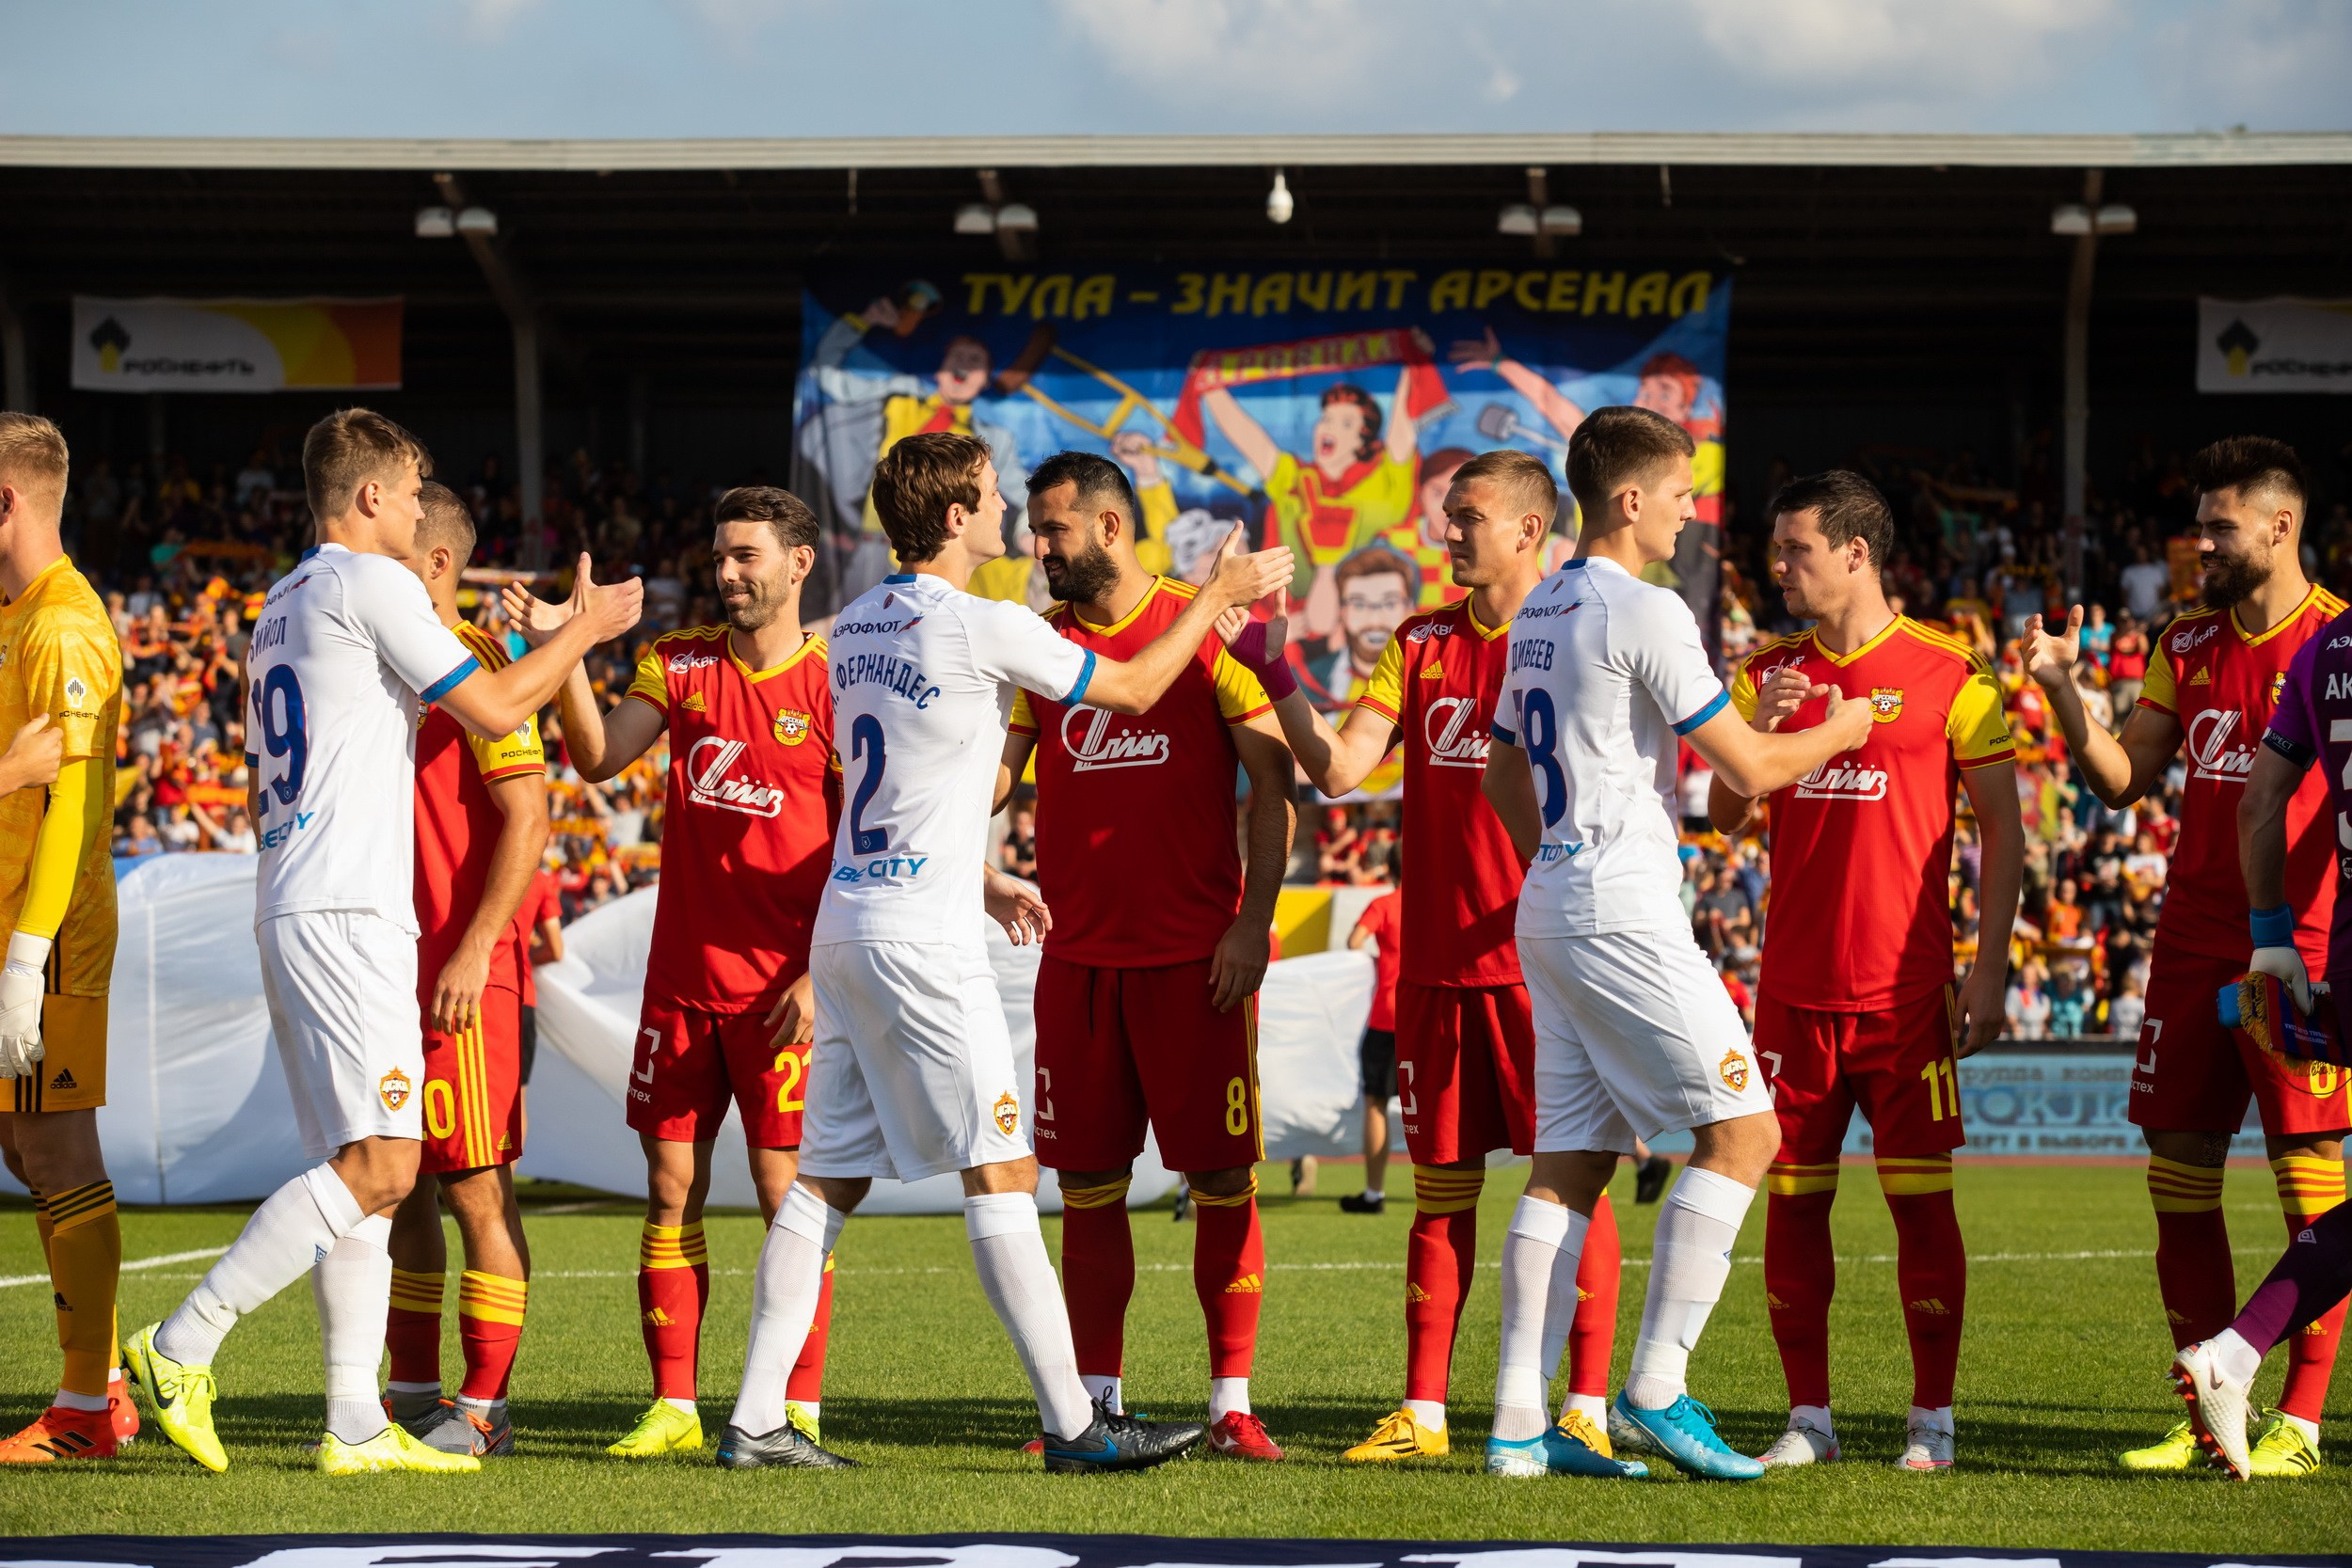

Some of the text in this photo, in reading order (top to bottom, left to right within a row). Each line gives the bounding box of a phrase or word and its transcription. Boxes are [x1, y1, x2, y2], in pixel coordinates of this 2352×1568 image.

[962, 273, 1116, 321] ТУЛА
[1171, 271, 1416, 318] ЗНАЧИТ
[1429, 270, 1712, 318] АРСЕНАЛ
[123, 356, 255, 375] РОСНЕФТЬ
[831, 620, 901, 641] АЭРОФЛОТ
[1512, 639, 1554, 675] ДИВЕЕВ
[836, 654, 940, 710] ФЕРНАНДЕС
[681, 701, 707, 713] adidas
[850, 713, 888, 856] 2
[382, 1079, 409, 1093] ЦСКА
[1723, 1060, 1747, 1076] ЦСКА
[1920, 1056, 1958, 1121] 11
[422, 1079, 456, 1140] 0
[1226, 1076, 1248, 1135] 8
